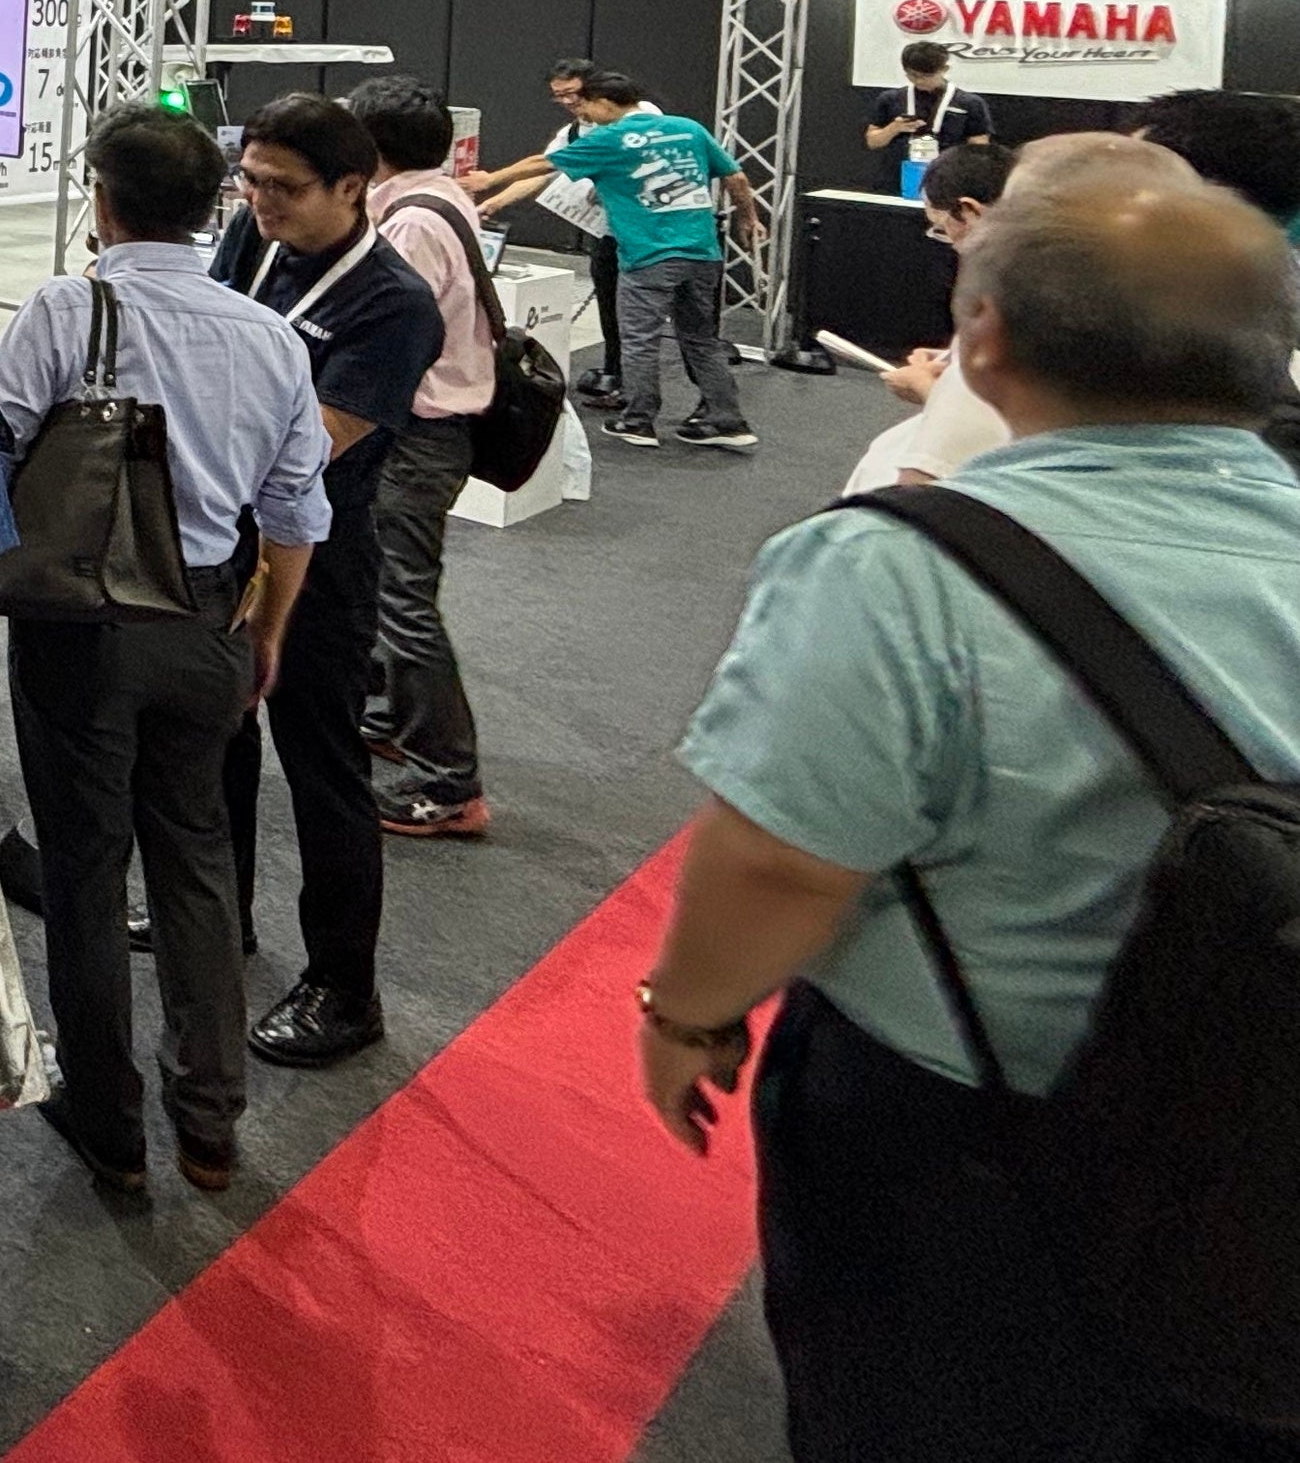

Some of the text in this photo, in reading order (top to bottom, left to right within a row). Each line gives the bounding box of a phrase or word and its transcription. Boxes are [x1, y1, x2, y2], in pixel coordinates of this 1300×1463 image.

[954, 0, 1177, 43] YAMAHA
[1018, 46, 1081, 63] Your
[38, 68, 50, 99] 7
[29, 142, 53, 173] 15
